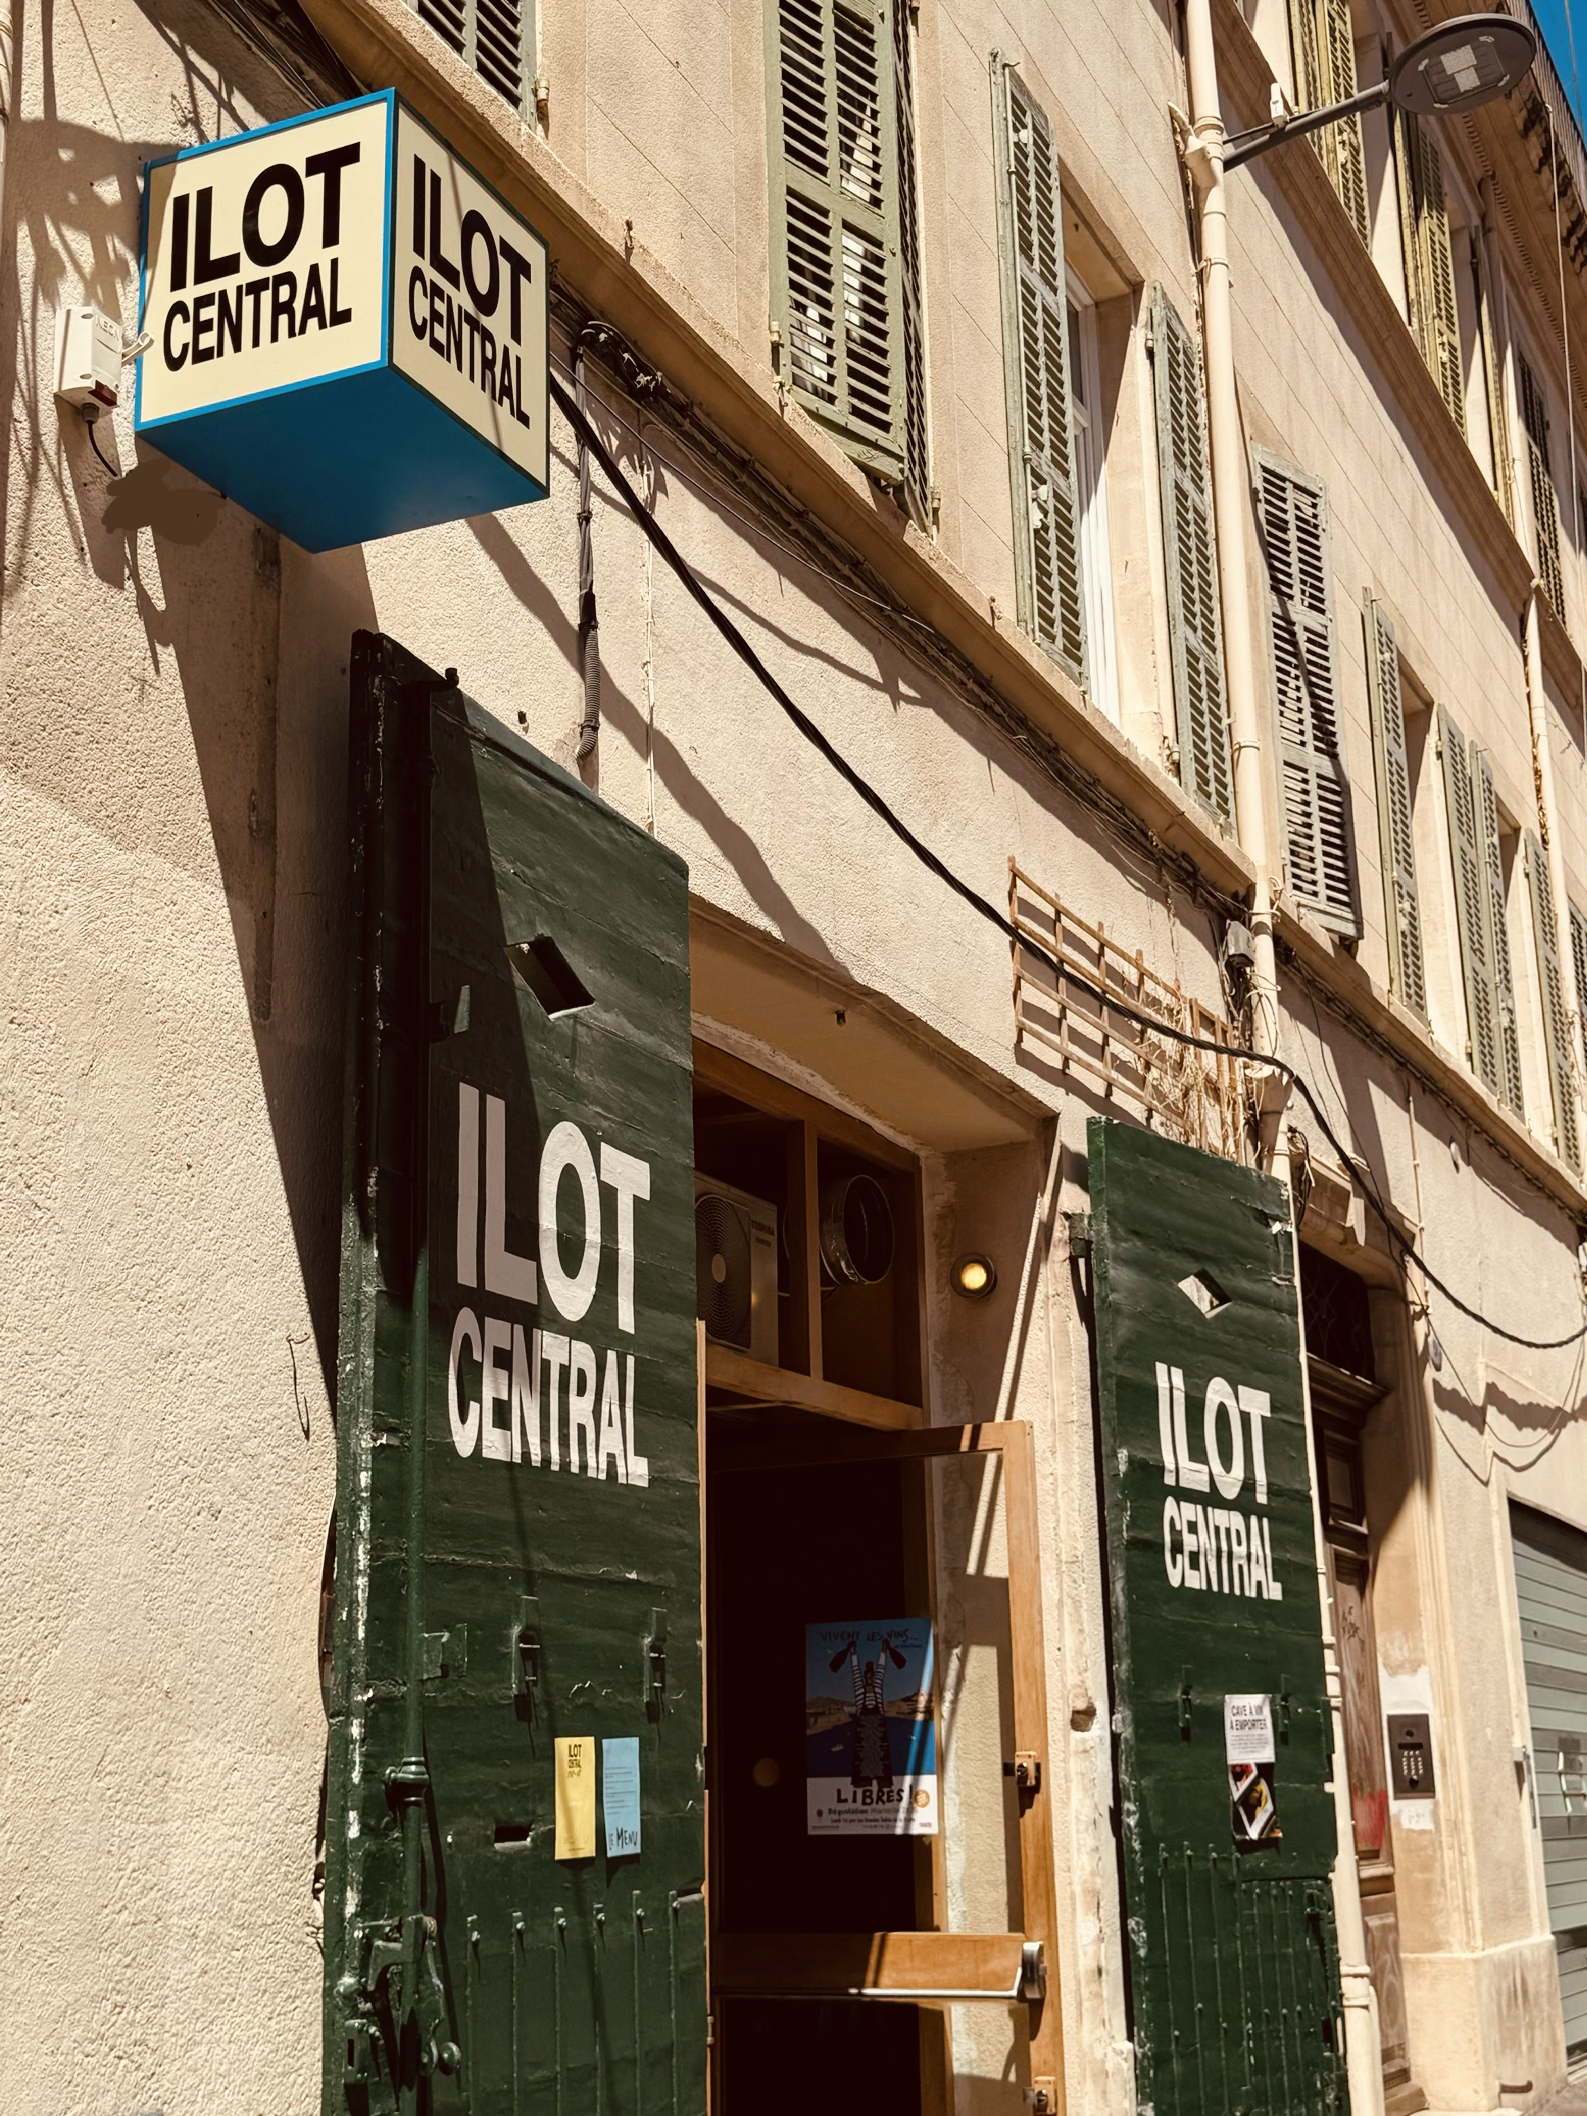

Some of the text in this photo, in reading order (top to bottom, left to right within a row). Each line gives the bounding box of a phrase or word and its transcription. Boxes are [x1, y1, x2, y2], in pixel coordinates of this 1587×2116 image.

[170, 142, 361, 293] ILOT
[413, 153, 532, 347] ILOT
[163, 257, 353, 372] CENTRAL
[408, 265, 531, 430] CENTRAL
[457, 1081, 651, 1335] ILOT
[448, 1306, 650, 1488] CENTRAL
[1155, 1361, 1272, 1505] ILOT
[1163, 1495, 1283, 1601] CENTRAL
[820, 1630, 860, 1642] VIVENT
[866, 1631, 884, 1642] LES
[568, 1744, 582, 1758] ILOT
[1231, 1704, 1248, 1716] CAVE
[1235, 1718, 1268, 1731] EMPORTER
[615, 1827, 638, 1849] MENU
